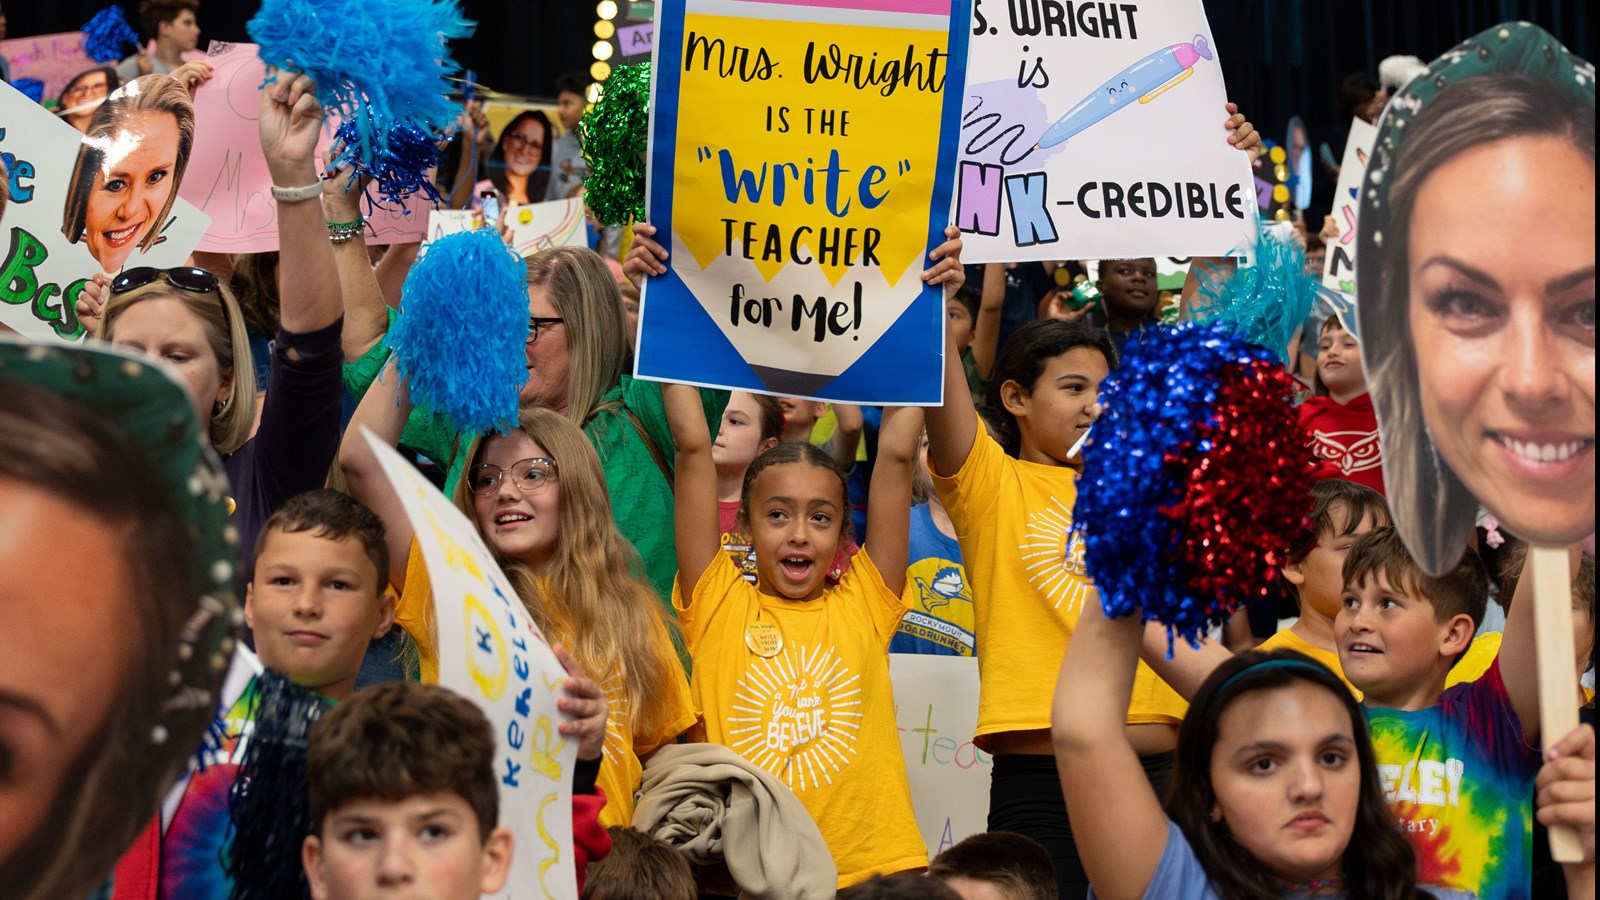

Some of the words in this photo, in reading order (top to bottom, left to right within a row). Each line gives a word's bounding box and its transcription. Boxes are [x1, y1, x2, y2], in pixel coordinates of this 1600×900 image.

[1008, 0, 1138, 39] WRIGHT
[685, 31, 783, 83] Mrs.
[804, 41, 952, 97] Wright
[1018, 45, 1050, 89] is
[766, 105, 790, 133] IS
[804, 108, 850, 136] THE
[720, 218, 881, 267] TEACHER
[729, 283, 782, 328] for
